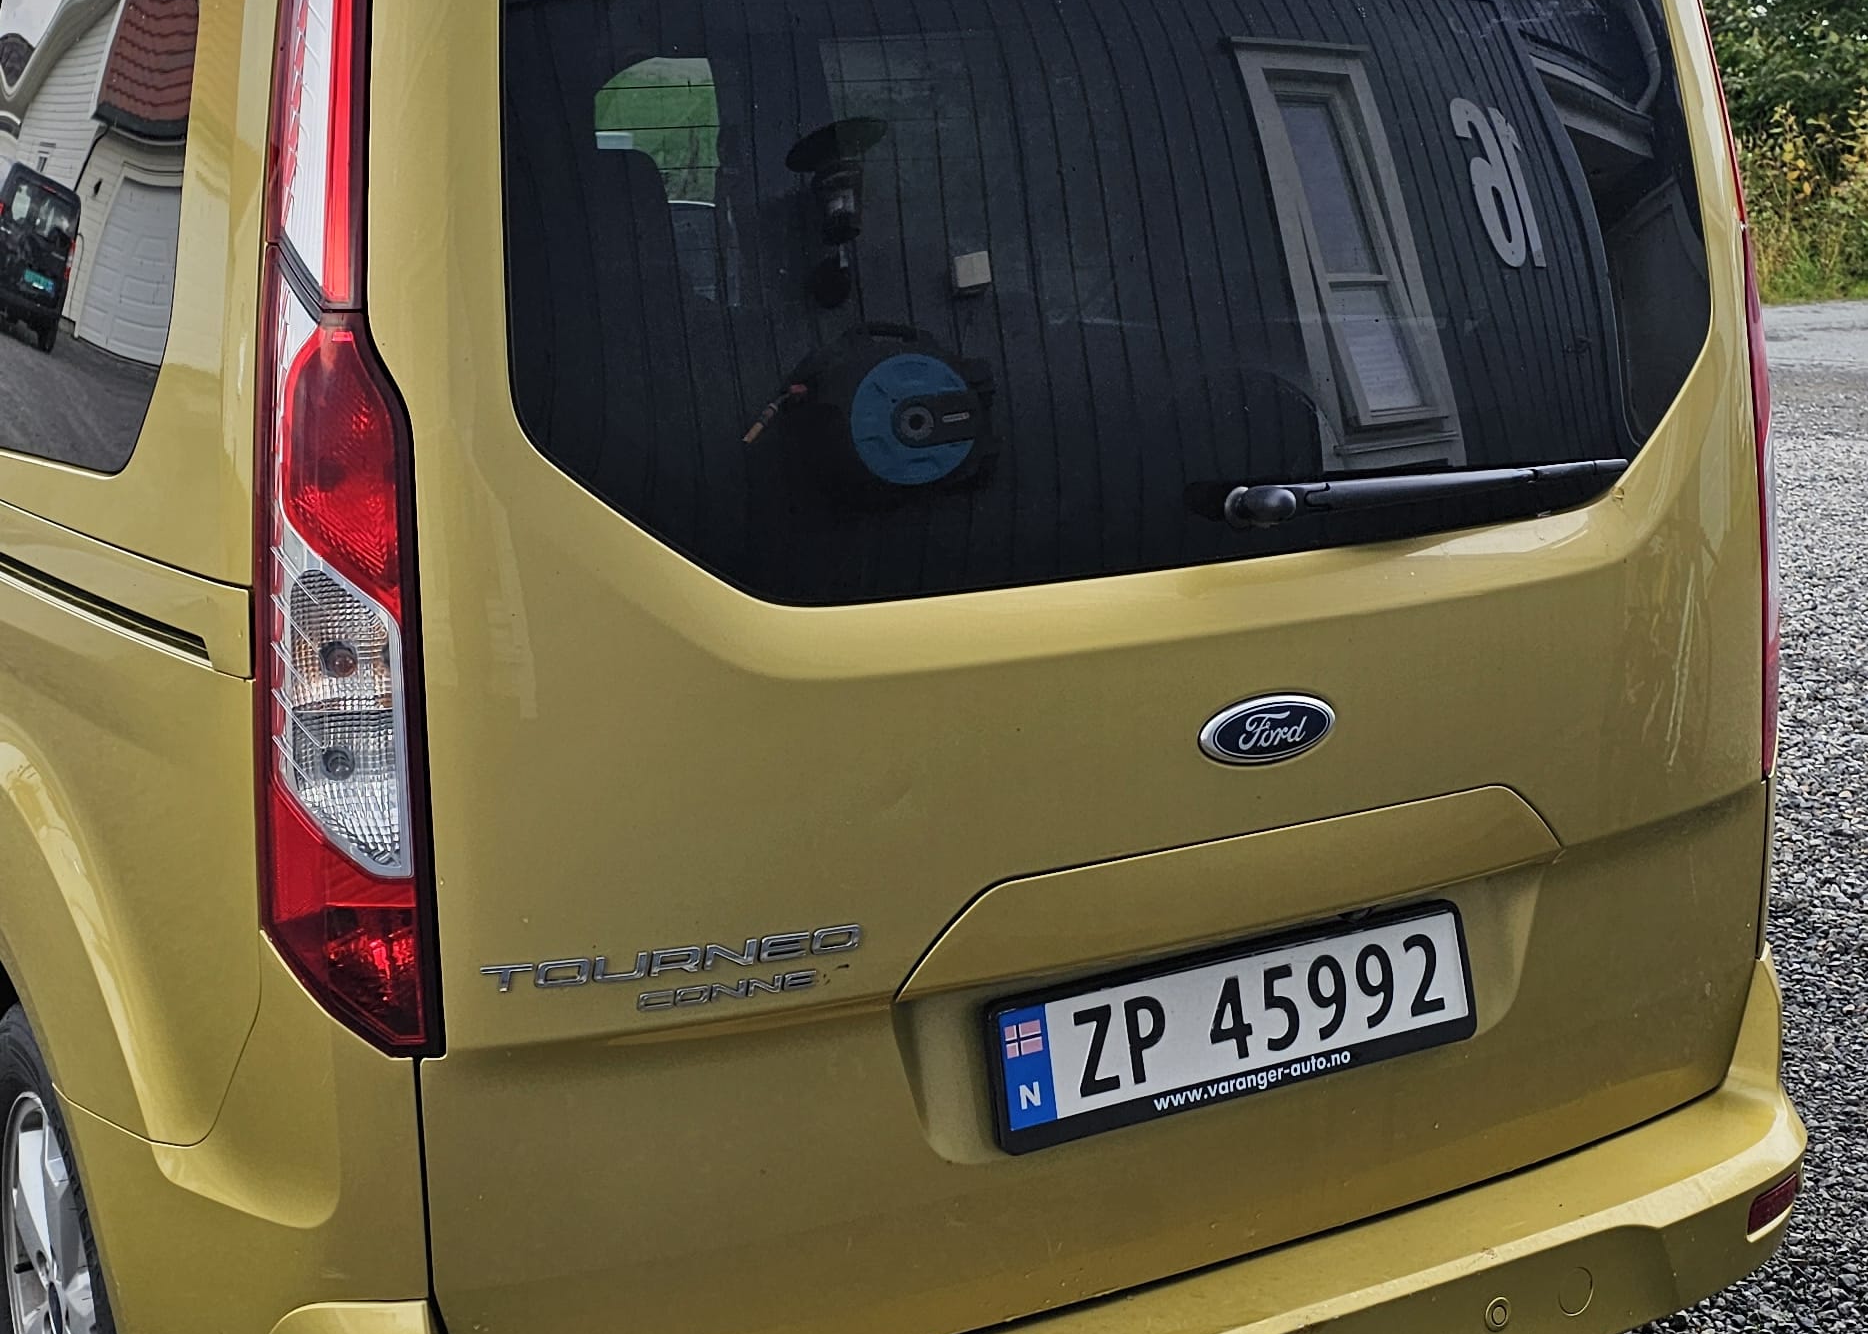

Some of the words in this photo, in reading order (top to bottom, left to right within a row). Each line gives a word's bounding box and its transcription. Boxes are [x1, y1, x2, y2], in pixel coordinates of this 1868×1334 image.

[1238, 710, 1308, 751] Ford
[479, 923, 862, 993] TOURNEO
[1073, 995, 1166, 1099] ZP
[1209, 932, 1447, 1060] 45992
[1018, 1080, 1042, 1111] N
[1153, 1048, 1352, 1113] www.varanger-auto.no
